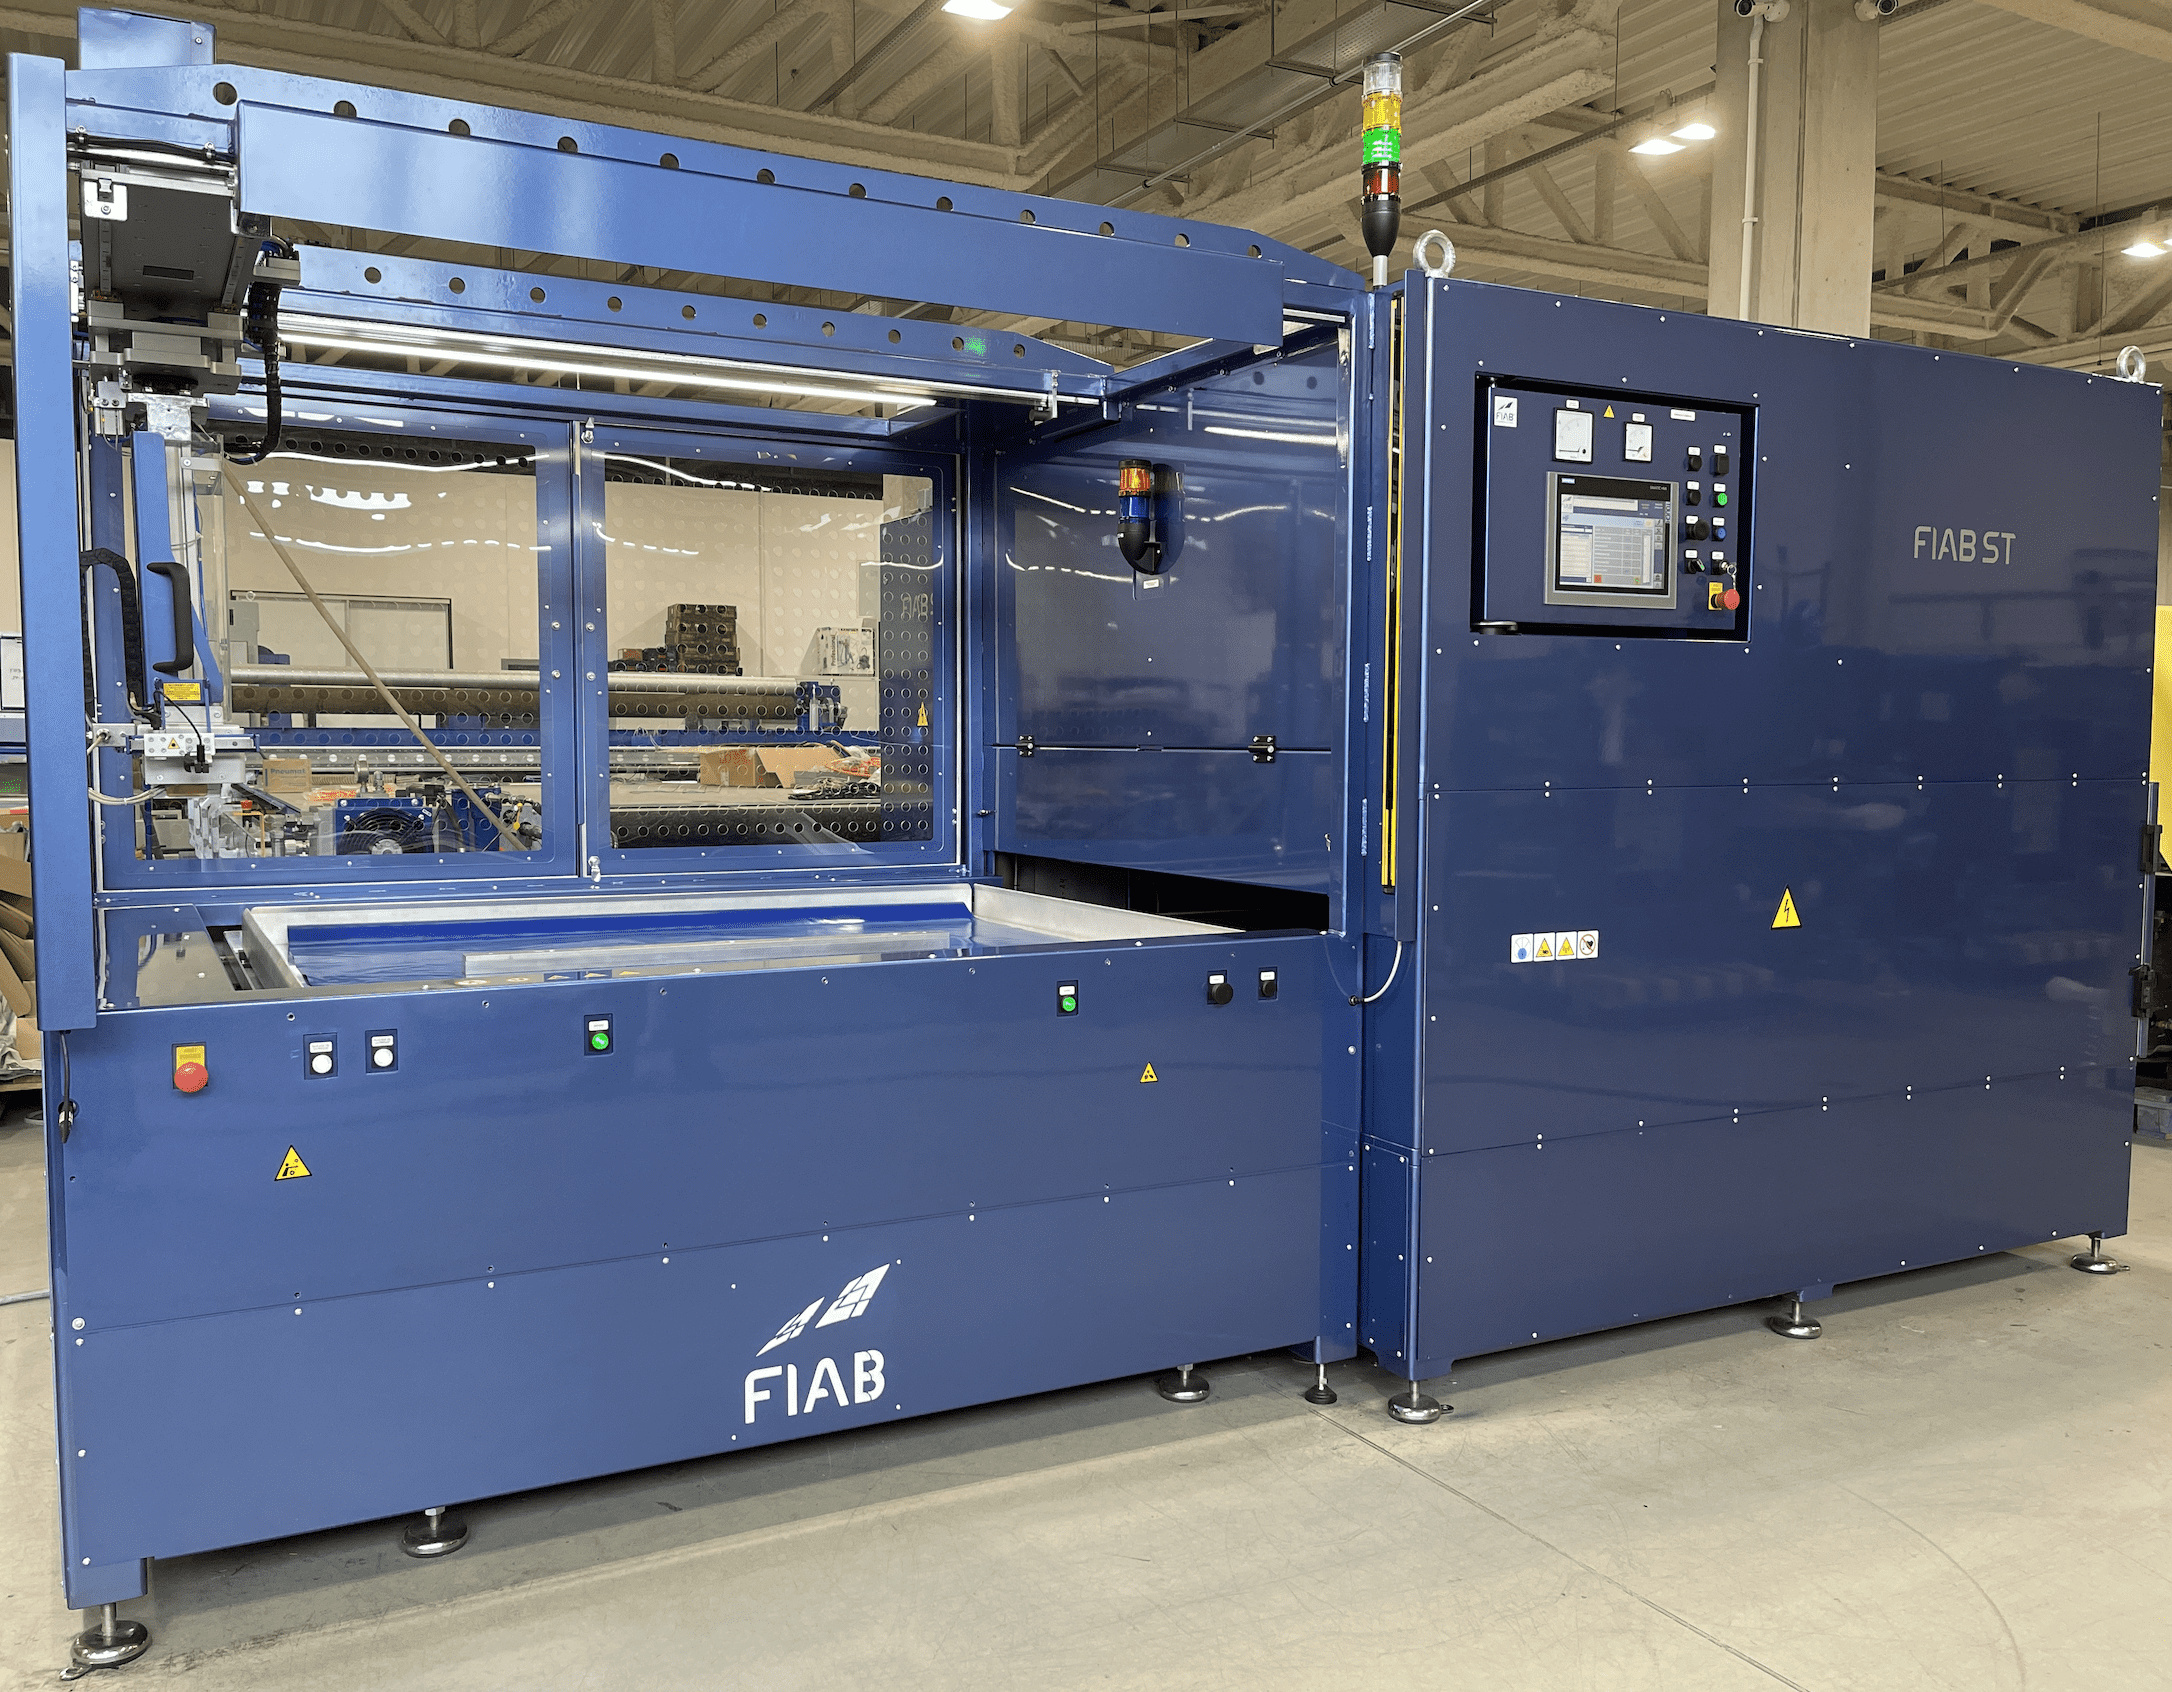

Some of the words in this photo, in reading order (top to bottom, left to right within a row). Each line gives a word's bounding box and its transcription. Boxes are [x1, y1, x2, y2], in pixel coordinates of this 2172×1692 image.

[1495, 411, 1514, 422] FIAB
[1913, 525, 1977, 563] FIAB
[1982, 530, 2017, 565] ST
[744, 1349, 886, 1425] FIAB
